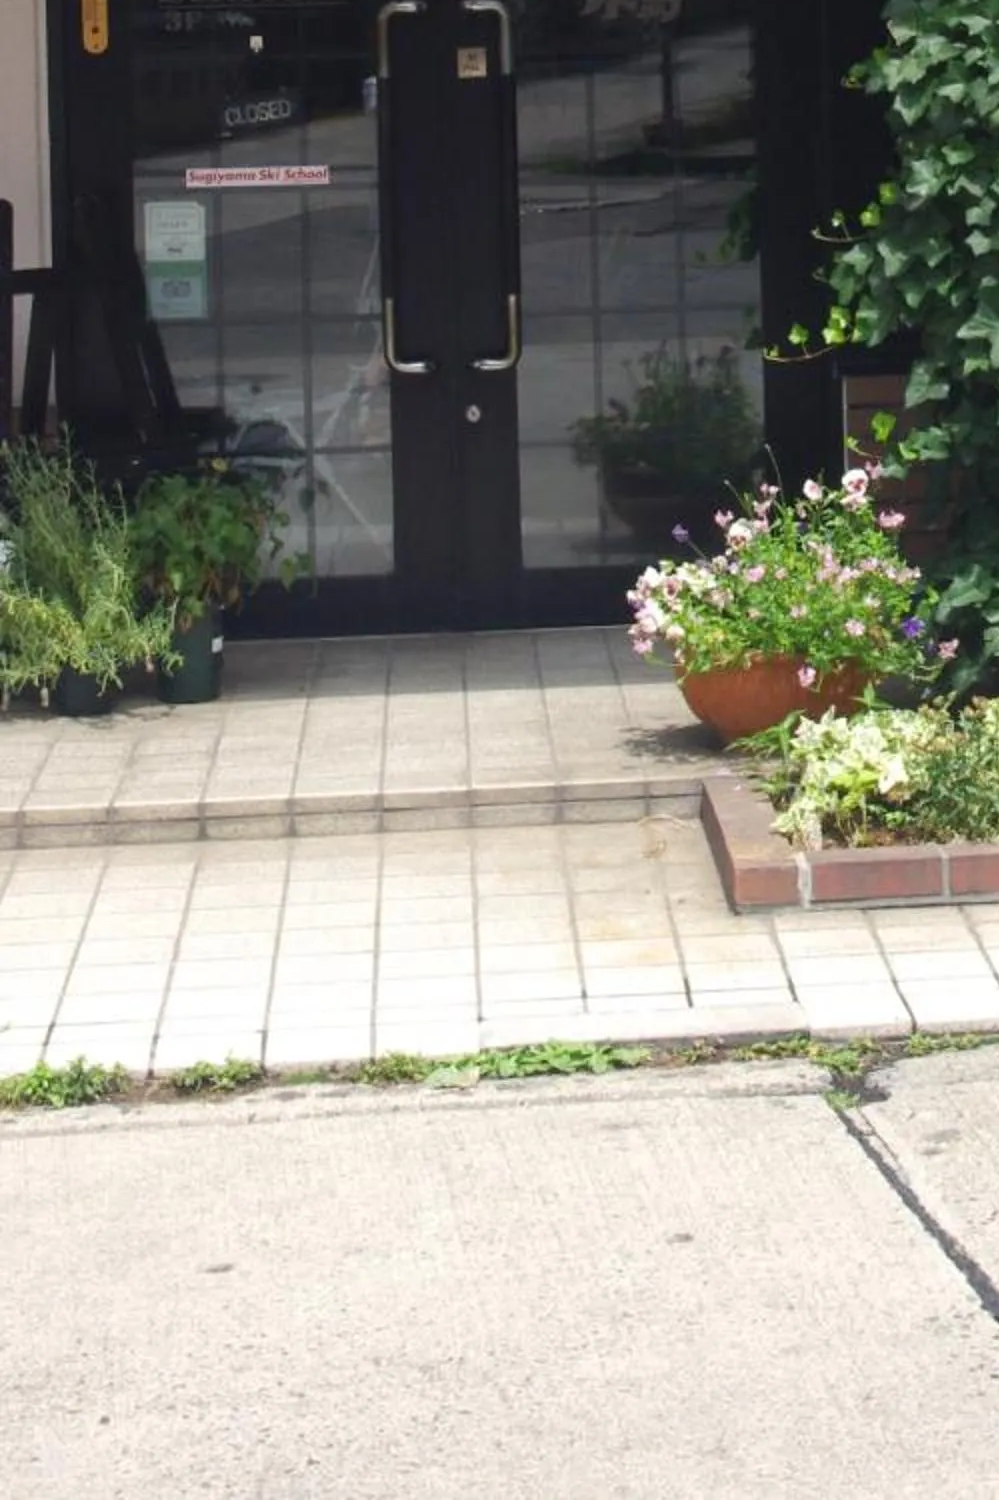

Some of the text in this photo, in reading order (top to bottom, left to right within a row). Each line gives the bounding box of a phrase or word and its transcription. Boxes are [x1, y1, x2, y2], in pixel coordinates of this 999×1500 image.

[223, 99, 292, 127] CLOSED
[258, 168, 280, 181] Ski
[284, 168, 327, 181] School
